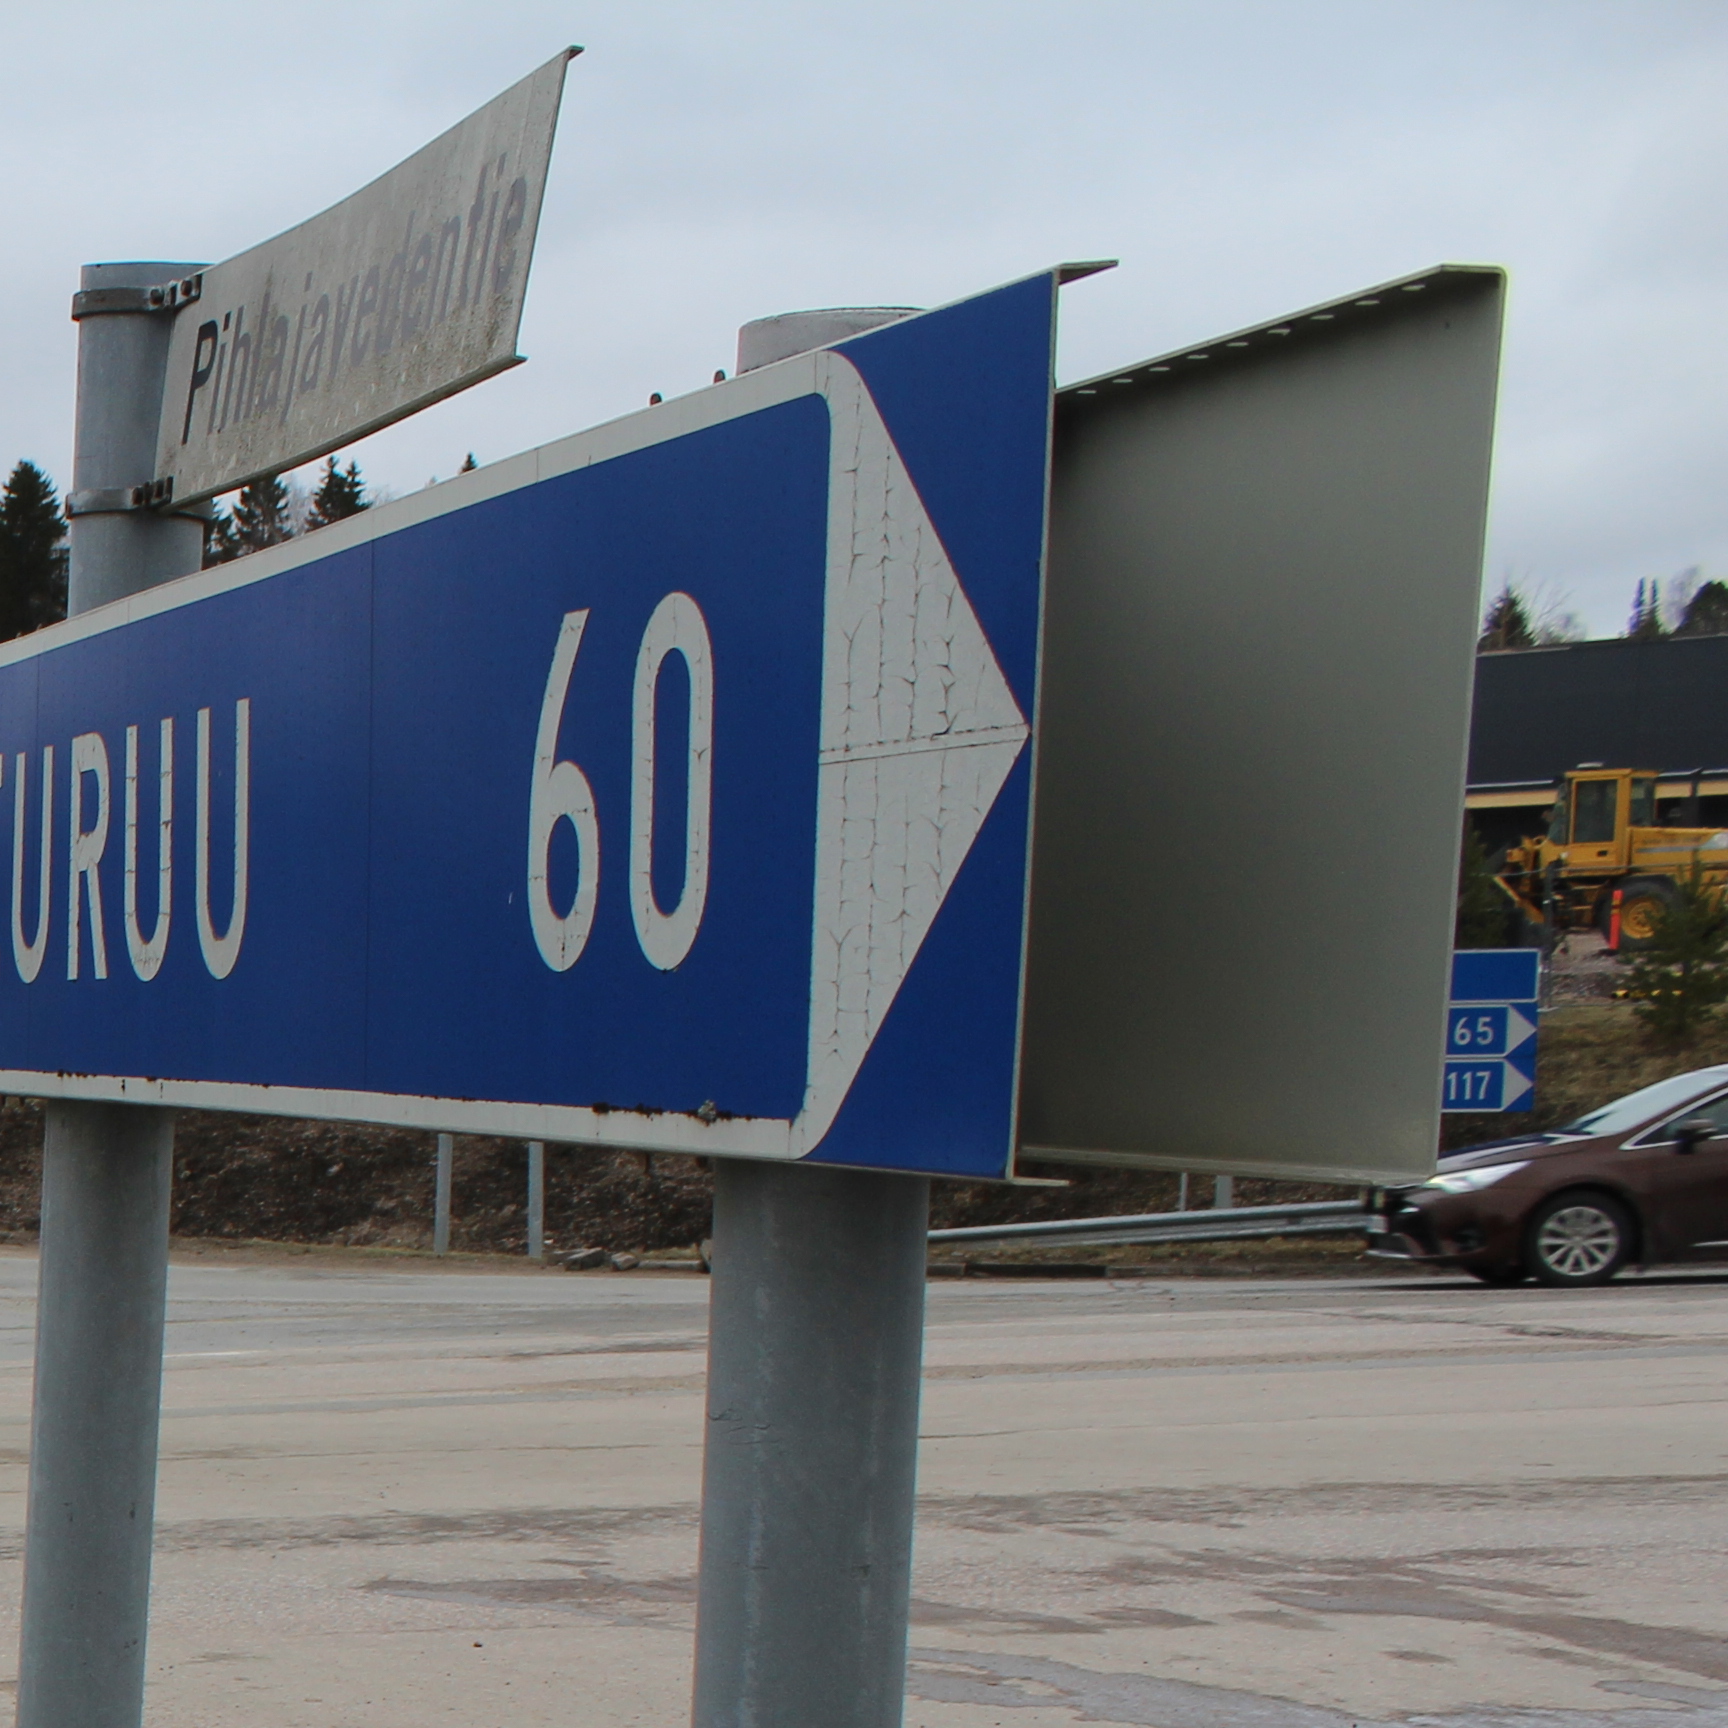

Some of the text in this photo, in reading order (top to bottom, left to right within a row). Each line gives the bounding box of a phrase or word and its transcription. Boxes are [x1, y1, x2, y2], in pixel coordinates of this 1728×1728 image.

[181, 152, 528, 445] Pihlajavedentie
[528, 591, 714, 972] 60
[1447, 1071, 1491, 1100] 117
[1454, 1016, 1494, 1046] 65
